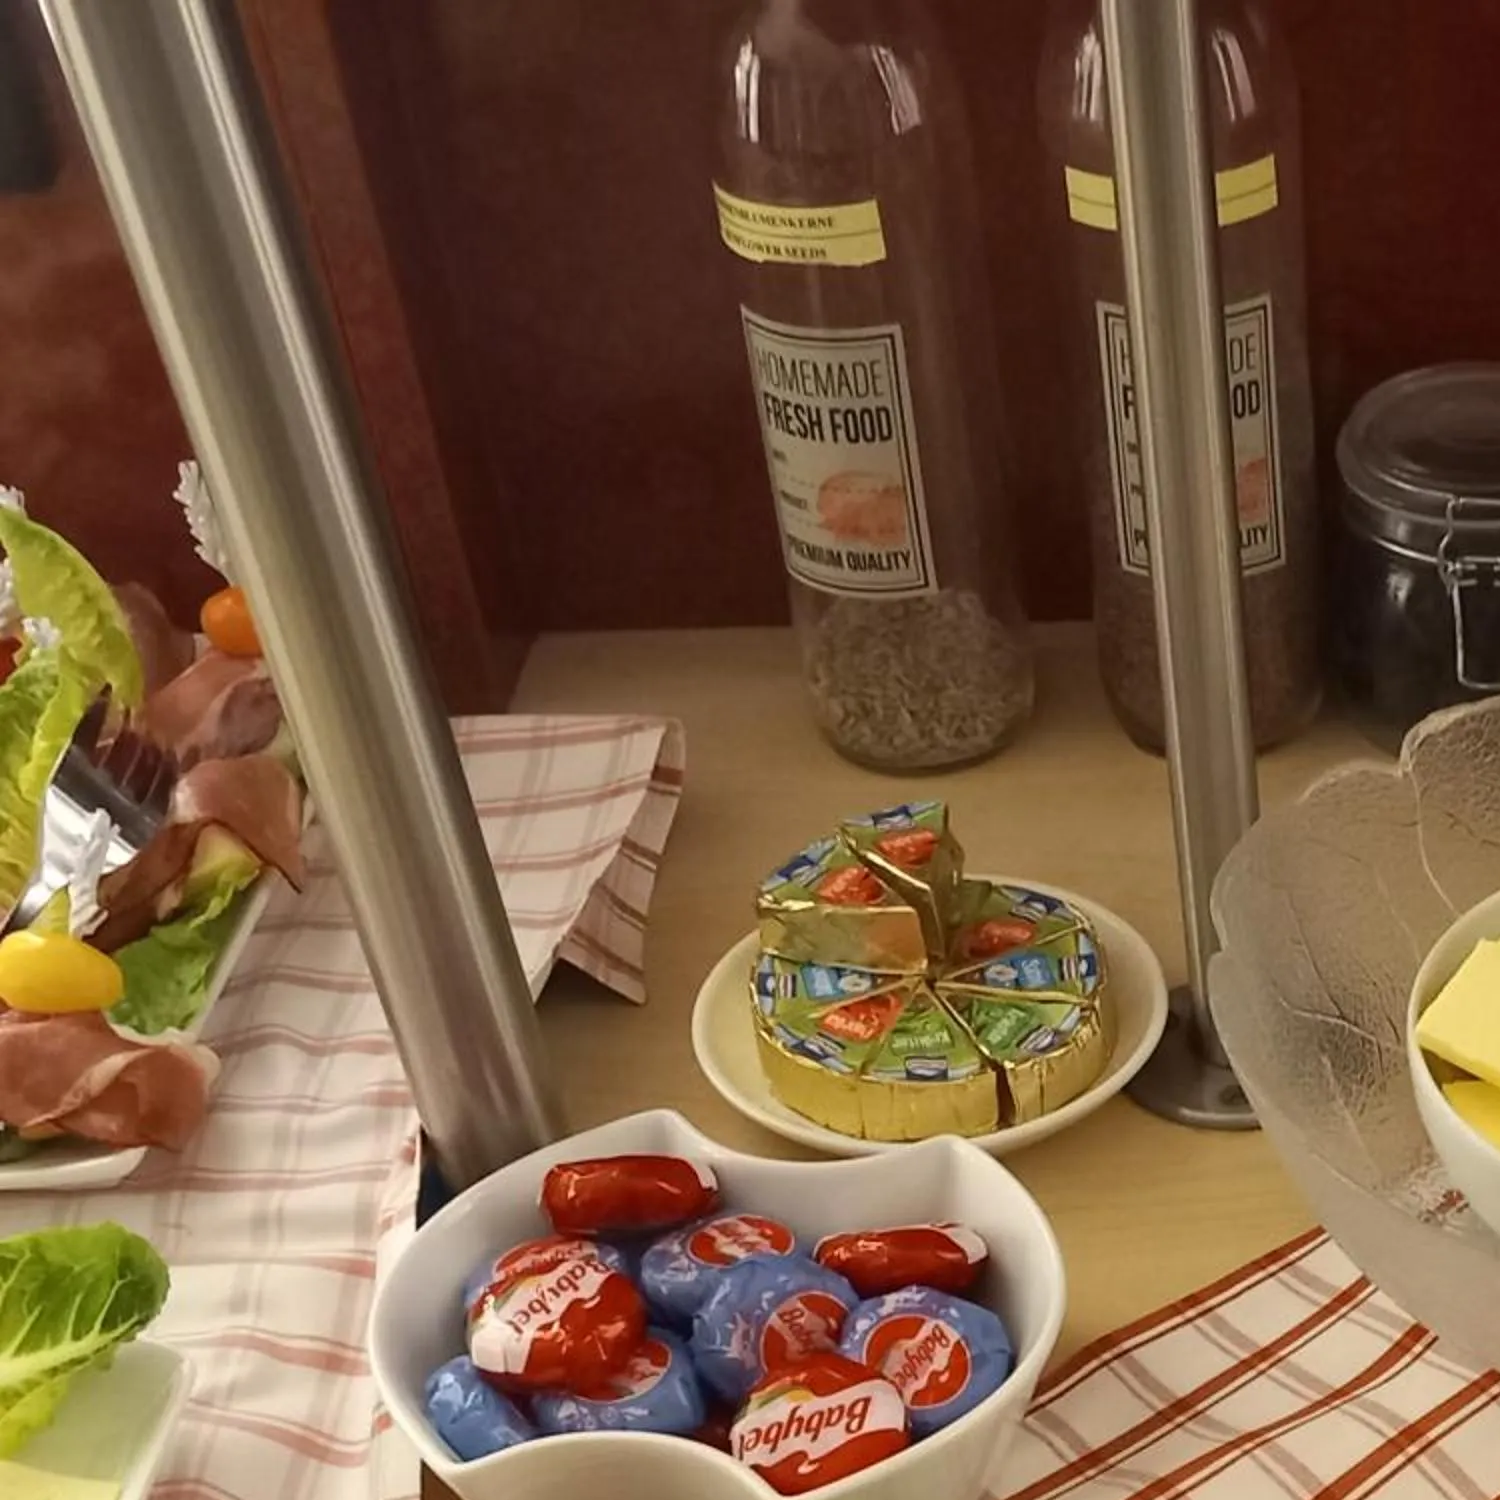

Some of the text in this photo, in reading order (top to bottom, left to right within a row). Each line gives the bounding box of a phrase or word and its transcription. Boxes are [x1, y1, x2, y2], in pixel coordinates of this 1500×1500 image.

[755, 348, 885, 399] HOMEMADE
[763, 391, 893, 444] FRESH FOOD
[846, 550, 913, 573] QUALITY
[506, 1258, 611, 1336] Babybel
[895, 1322, 951, 1387] Babybe
[738, 1395, 873, 1462] Babybel
